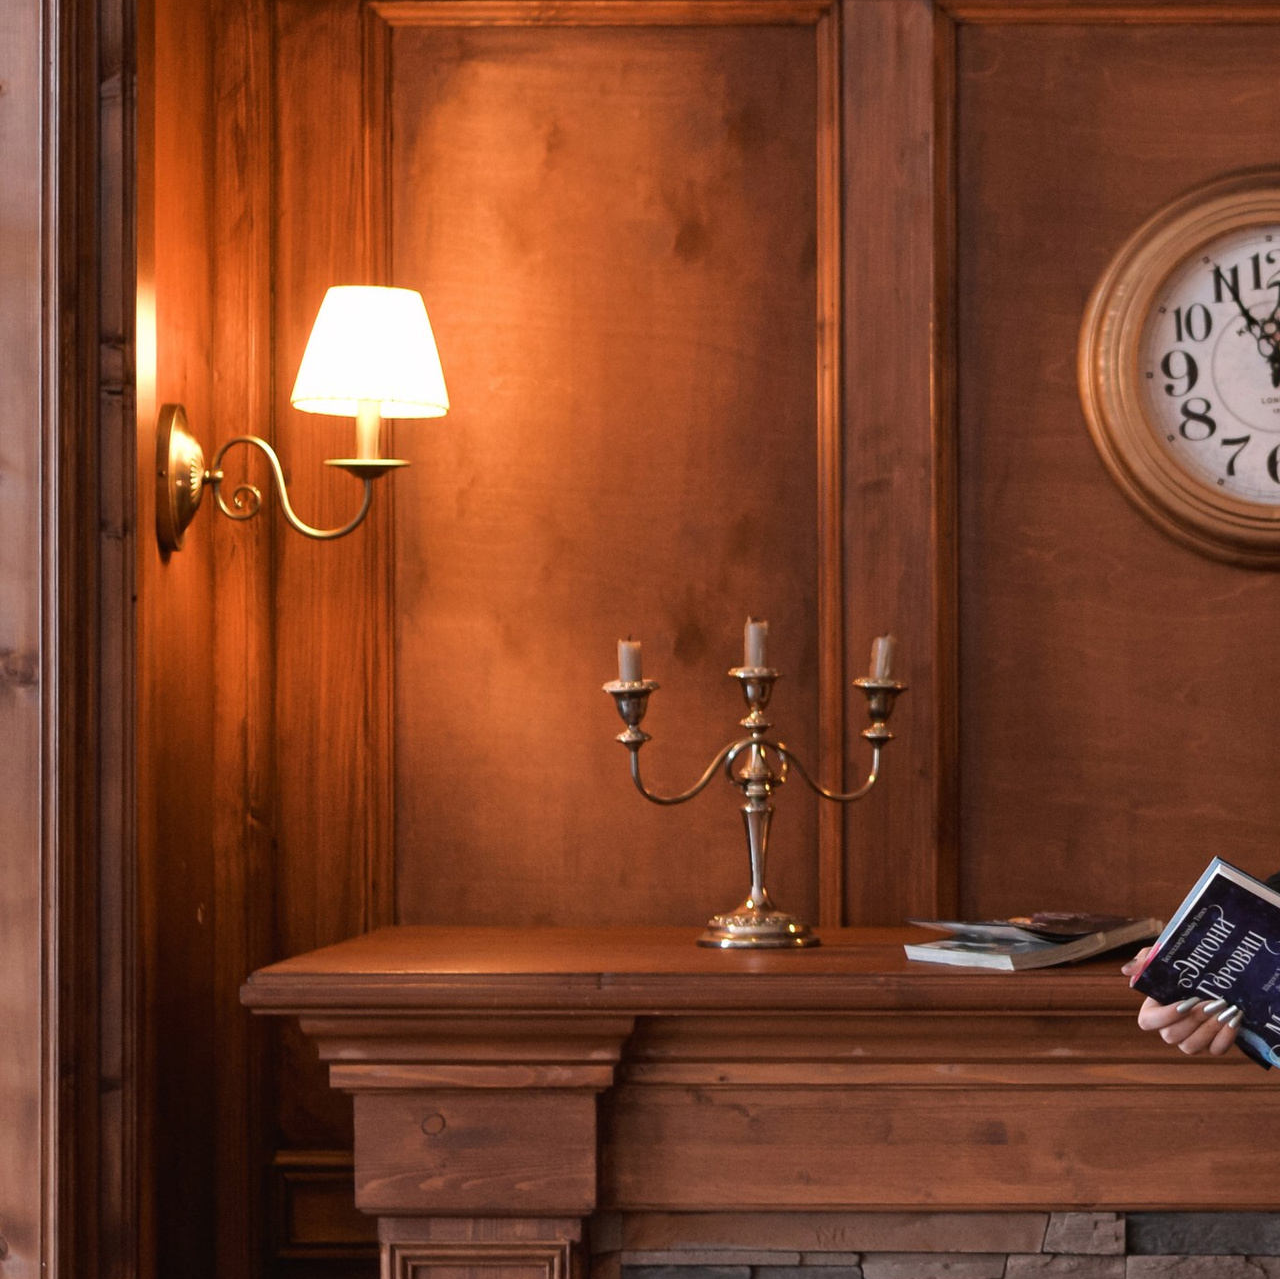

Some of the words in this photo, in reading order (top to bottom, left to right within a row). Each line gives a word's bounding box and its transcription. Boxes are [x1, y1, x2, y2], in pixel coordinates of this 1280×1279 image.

[1173, 303, 1212, 342] 10
[1161, 350, 1199, 397] 9
[1179, 397, 1217, 441] 8
[1220, 435, 1251, 476] 7
